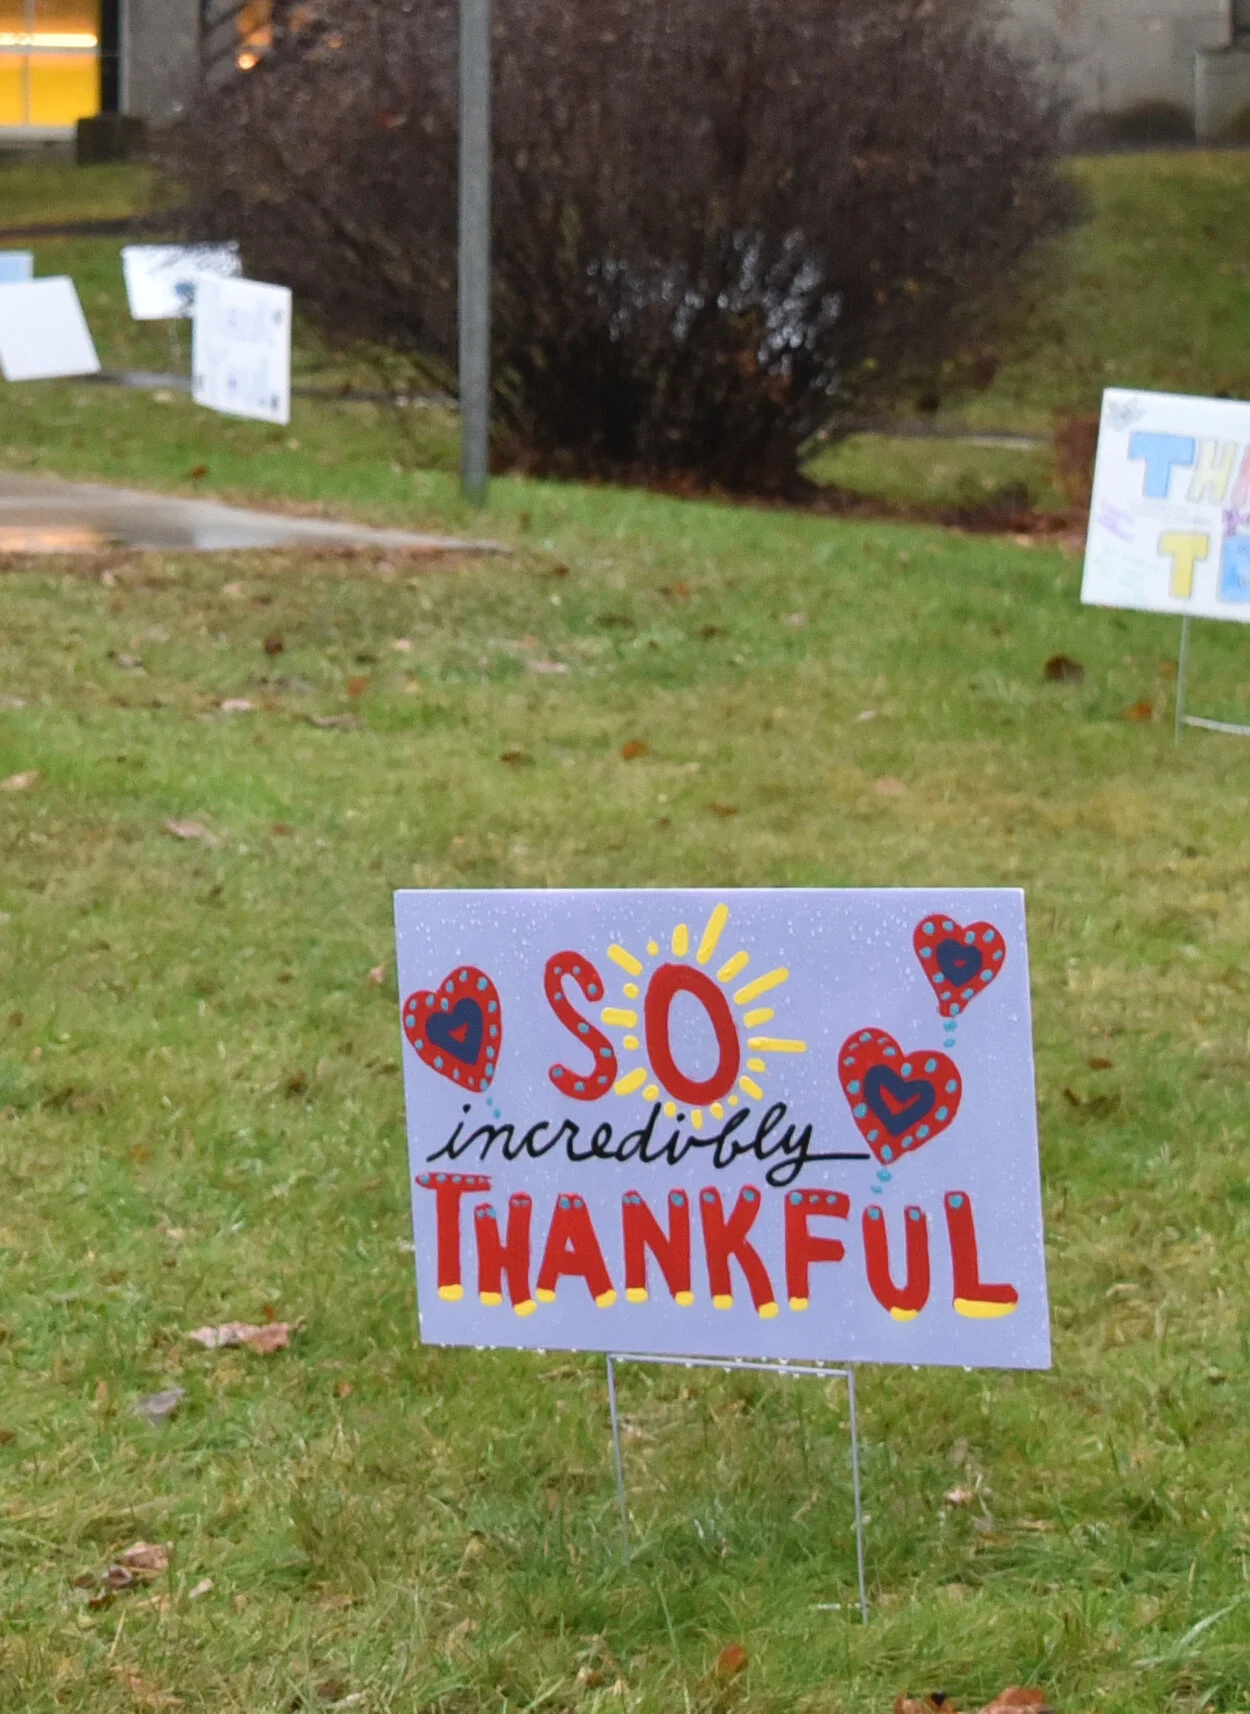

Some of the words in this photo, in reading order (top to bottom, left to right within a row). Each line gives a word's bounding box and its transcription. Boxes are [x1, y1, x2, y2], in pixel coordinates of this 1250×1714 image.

[543, 951, 740, 1106] SO
[427, 1102, 870, 1187] incredibly
[416, 1172, 1020, 1320] THANKFUL
